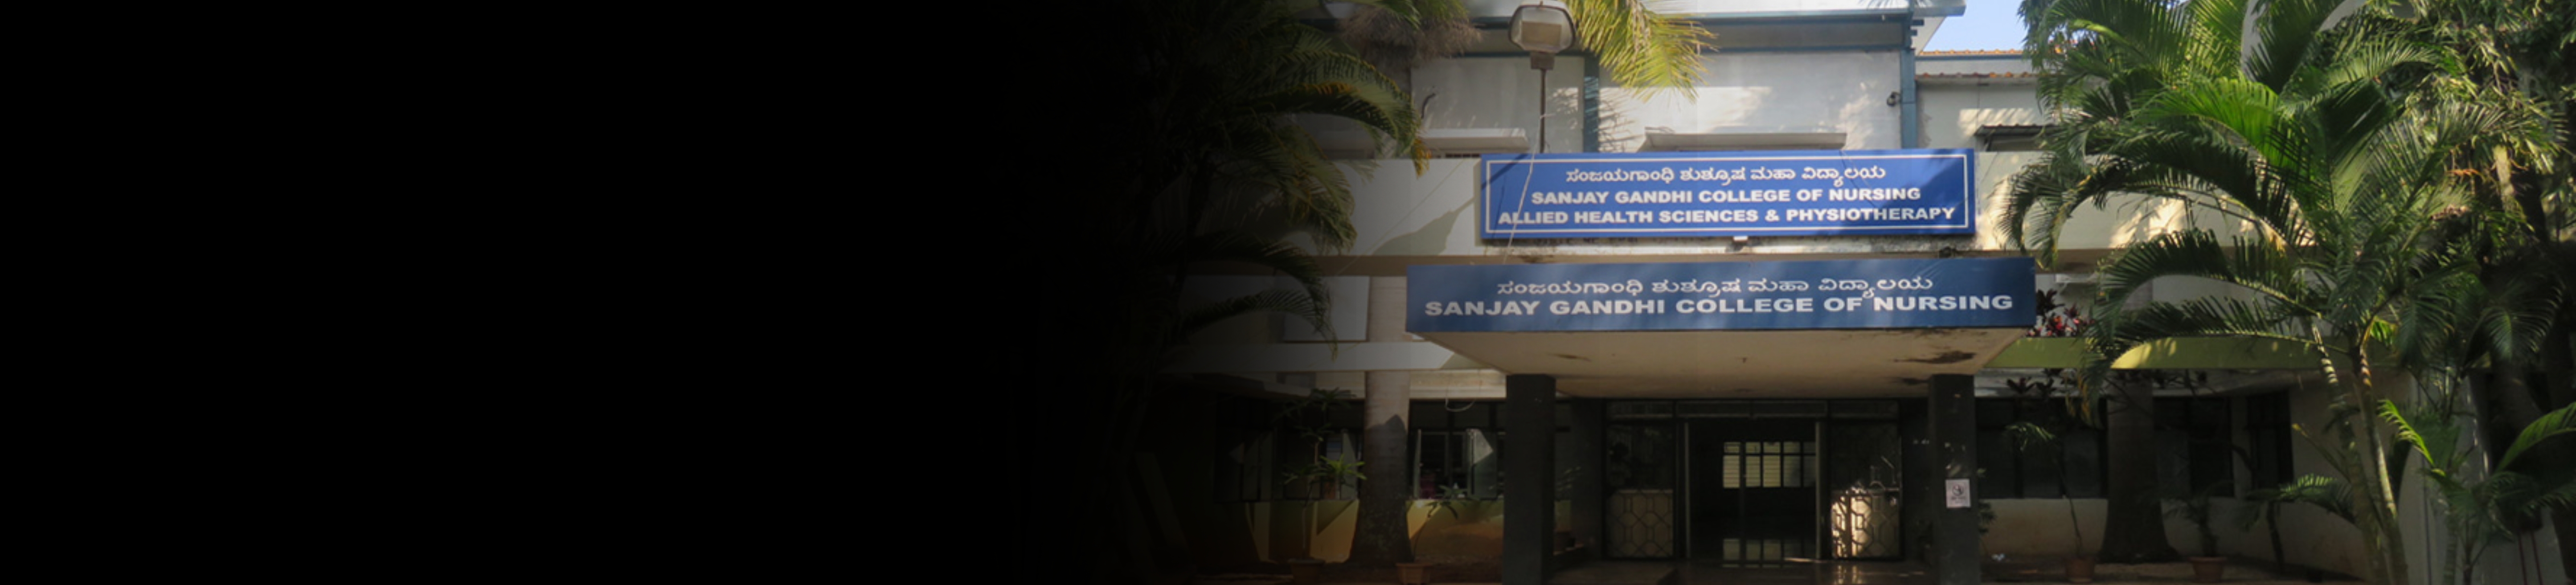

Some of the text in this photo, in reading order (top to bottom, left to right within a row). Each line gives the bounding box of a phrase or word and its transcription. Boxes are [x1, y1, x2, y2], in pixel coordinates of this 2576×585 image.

[1566, 168, 1675, 184] ಸಂಜಯಗಾಂಧಿ
[1750, 166, 1796, 180] ಮಹಾ
[1801, 165, 1886, 188] ವಿದ್ಯಾಲಯ
[1531, 188, 1921, 205] SANJAY GANDHI COLLEGE OF NURSING
[1497, 208, 1956, 225] ALLIED HEALTH SCIENCES & PHYSIOTHERAPY
[1498, 280, 1643, 296] ಸಂಜಯಗಾಂಧಿ
[1748, 277, 1810, 292] ಮಹಾ
[1818, 275, 1933, 299] ವಿದ್ಯಾಲಯ
[1425, 294, 2013, 316] SANJAY GANDHI COLLEGE OF NURSING
